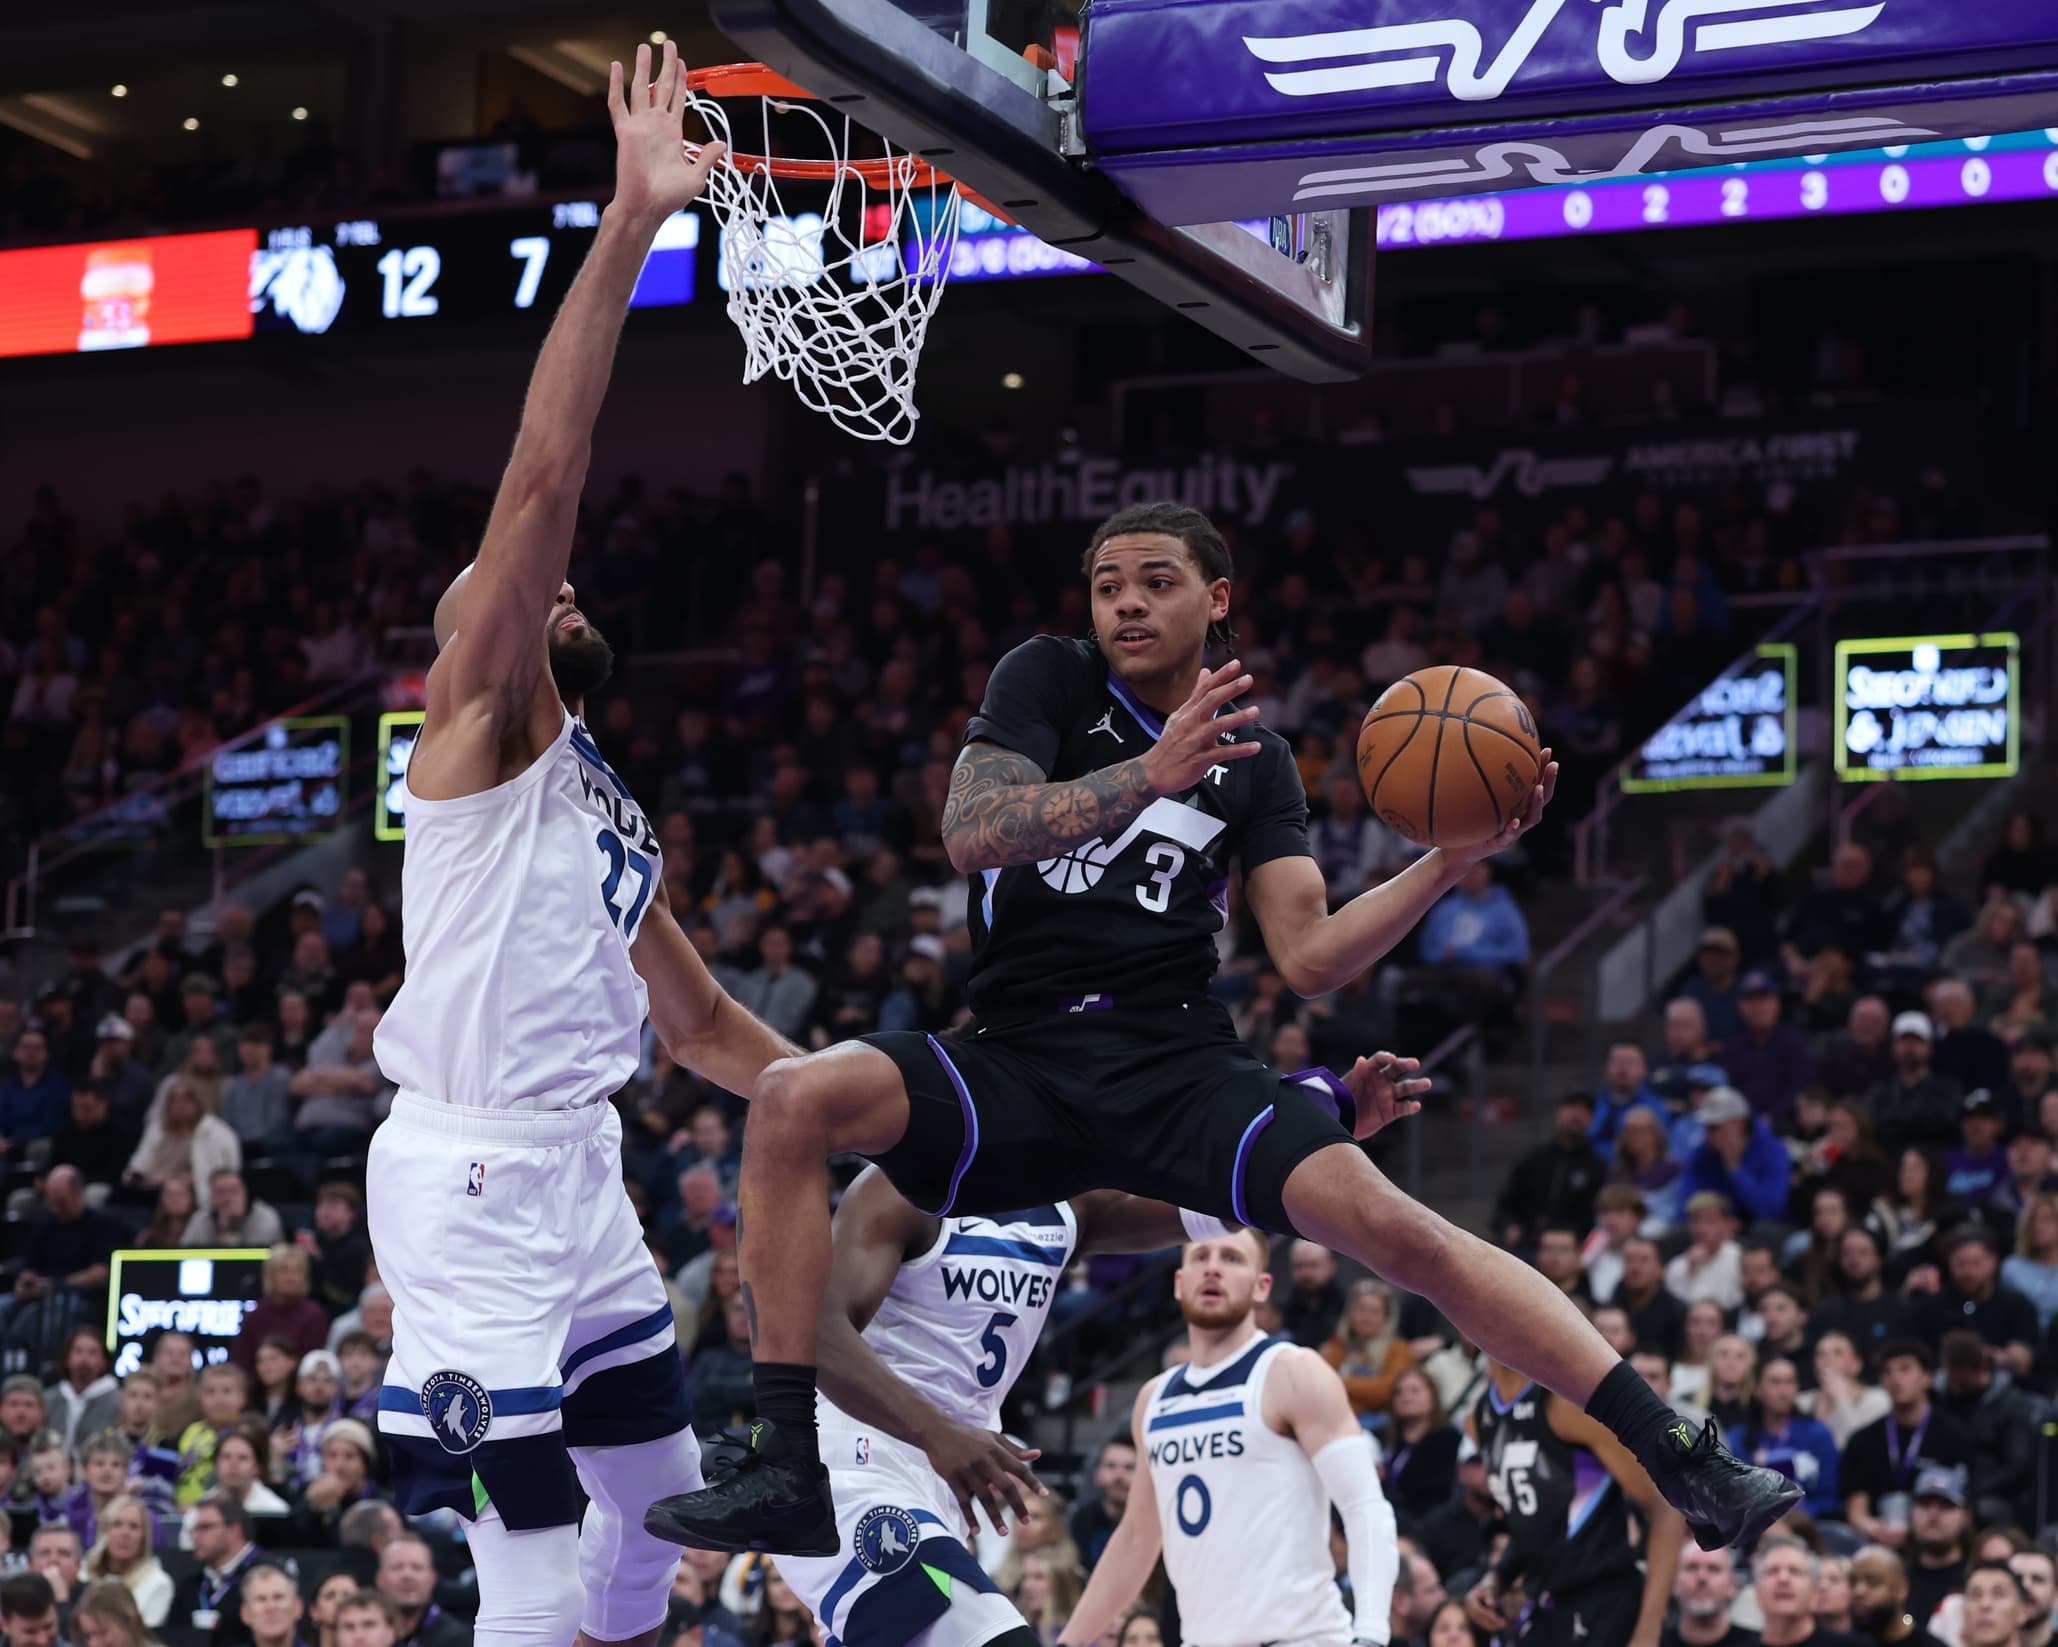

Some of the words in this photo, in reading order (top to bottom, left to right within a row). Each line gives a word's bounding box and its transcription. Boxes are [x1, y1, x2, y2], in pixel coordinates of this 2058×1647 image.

[1563, 191, 1593, 229] 0
[1643, 184, 1670, 223] 2
[1721, 178, 1748, 217] 2
[1800, 171, 1828, 210] 3
[1880, 164, 1910, 204] 0
[1961, 157, 1992, 197] 0
[377, 246, 439, 318] 12
[510, 237, 550, 308] 7
[596, 828, 653, 938] 27
[1135, 841, 1185, 913] 3
[940, 1266, 1053, 1309] WOLVES
[976, 1312, 1018, 1388] 5
[448, 1373, 489, 1439] TIMBERWOLVES
[1149, 1430, 1244, 1468] WOLVES
[868, 1506, 918, 1543] TIMBERWOLVES
[1176, 1473, 1212, 1537] 0
[1510, 1469, 1538, 1517] 5
